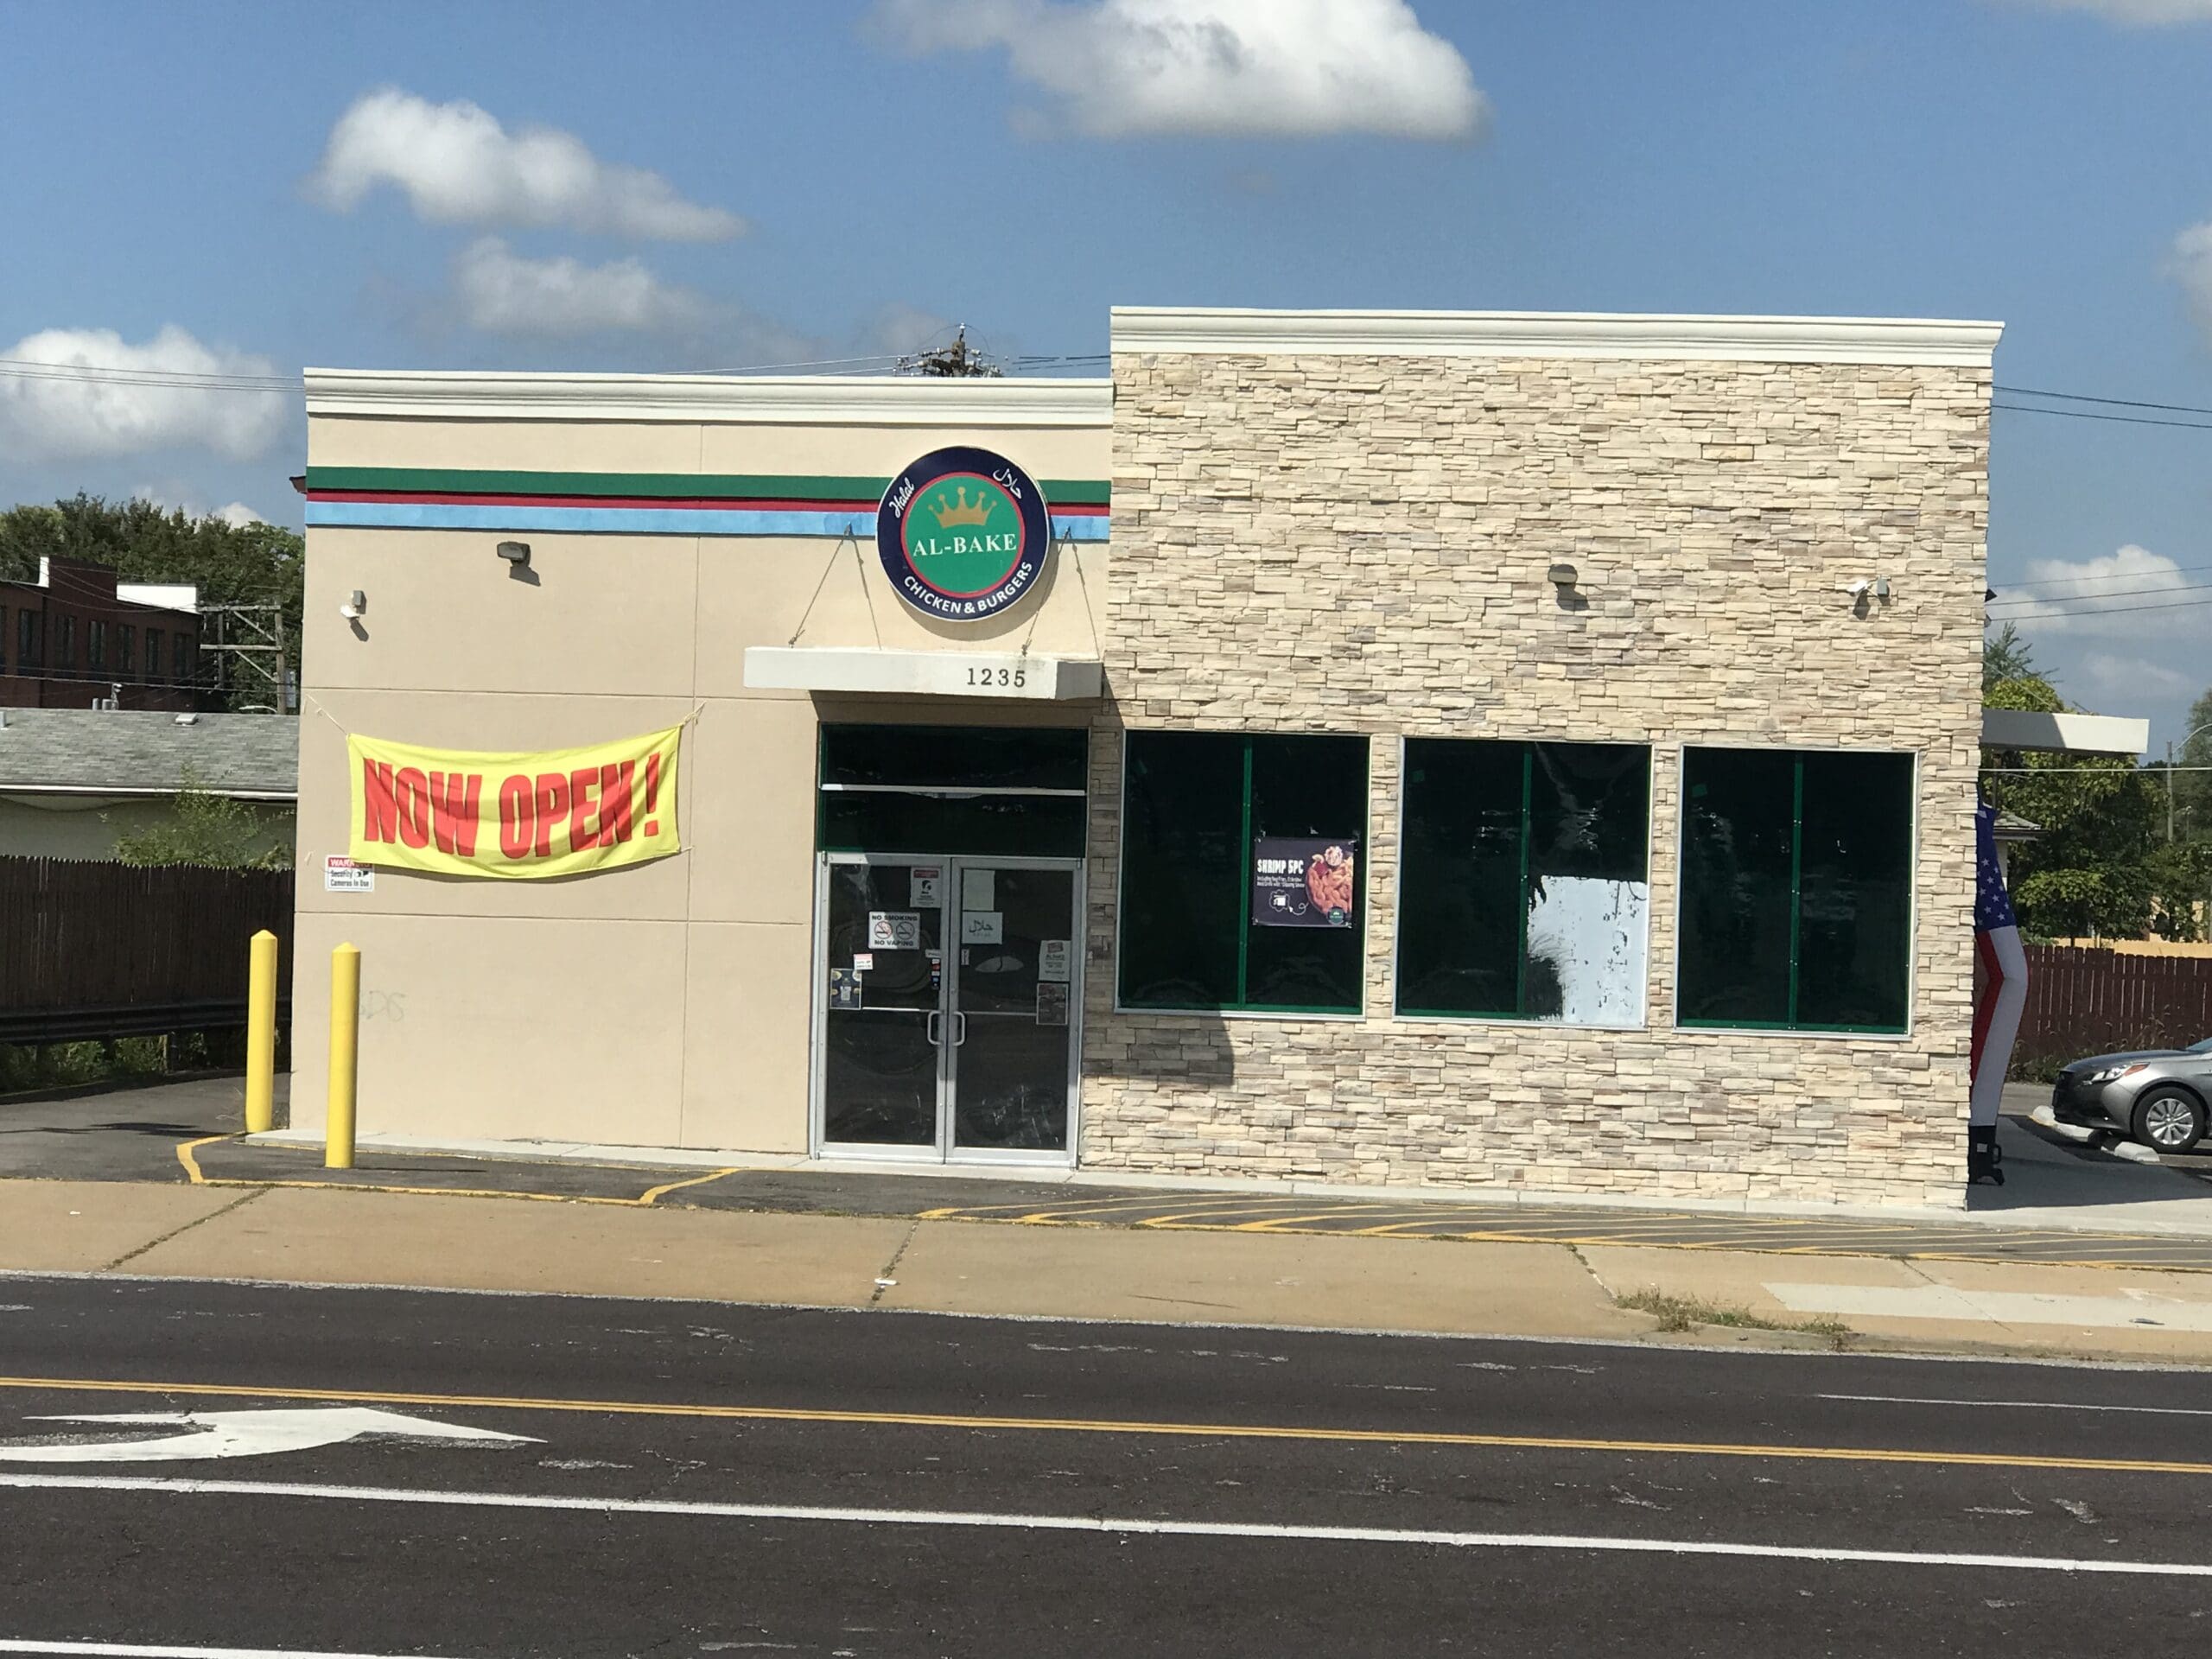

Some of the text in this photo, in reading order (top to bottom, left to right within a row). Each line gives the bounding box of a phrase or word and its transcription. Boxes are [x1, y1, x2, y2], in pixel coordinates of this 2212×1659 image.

[888, 477, 915, 518] Halal
[912, 533, 1018, 557] AL-BAKE
[904, 561, 1033, 614] CHICKEN & BURGERS
[967, 667, 1026, 688] 1235
[363, 752, 661, 860] NOW OPEN!
[330, 869, 353, 879] Security
[1257, 859, 1304, 874] SHRIMP 5PC
